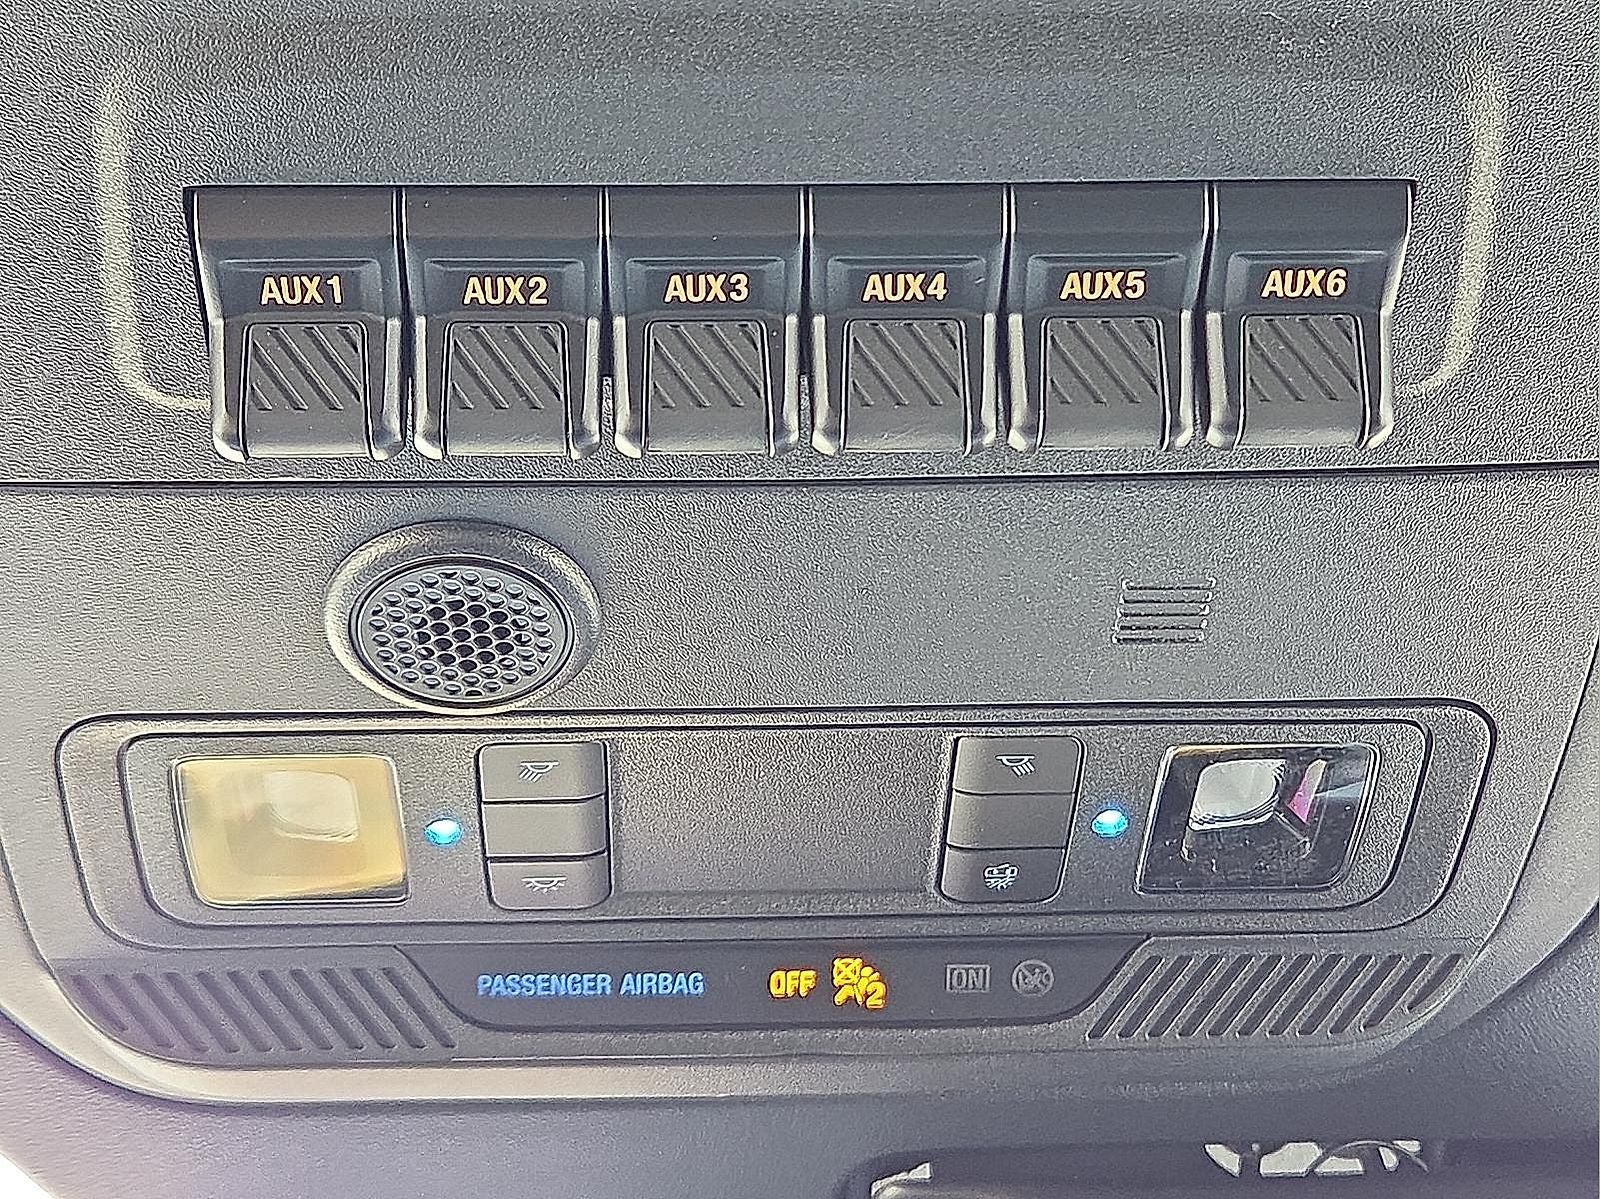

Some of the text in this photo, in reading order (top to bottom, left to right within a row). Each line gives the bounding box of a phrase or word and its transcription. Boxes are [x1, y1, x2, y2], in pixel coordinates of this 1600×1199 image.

[463, 275, 549, 305] AUX2
[663, 273, 750, 303] AUX3
[862, 272, 948, 302] AUX4
[1059, 270, 1147, 300] AUX5
[1261, 268, 1347, 298] AUX6
[476, 972, 705, 997] PASSENGER AIRBAG
[769, 969, 817, 998] OFF
[951, 967, 984, 990] ON
